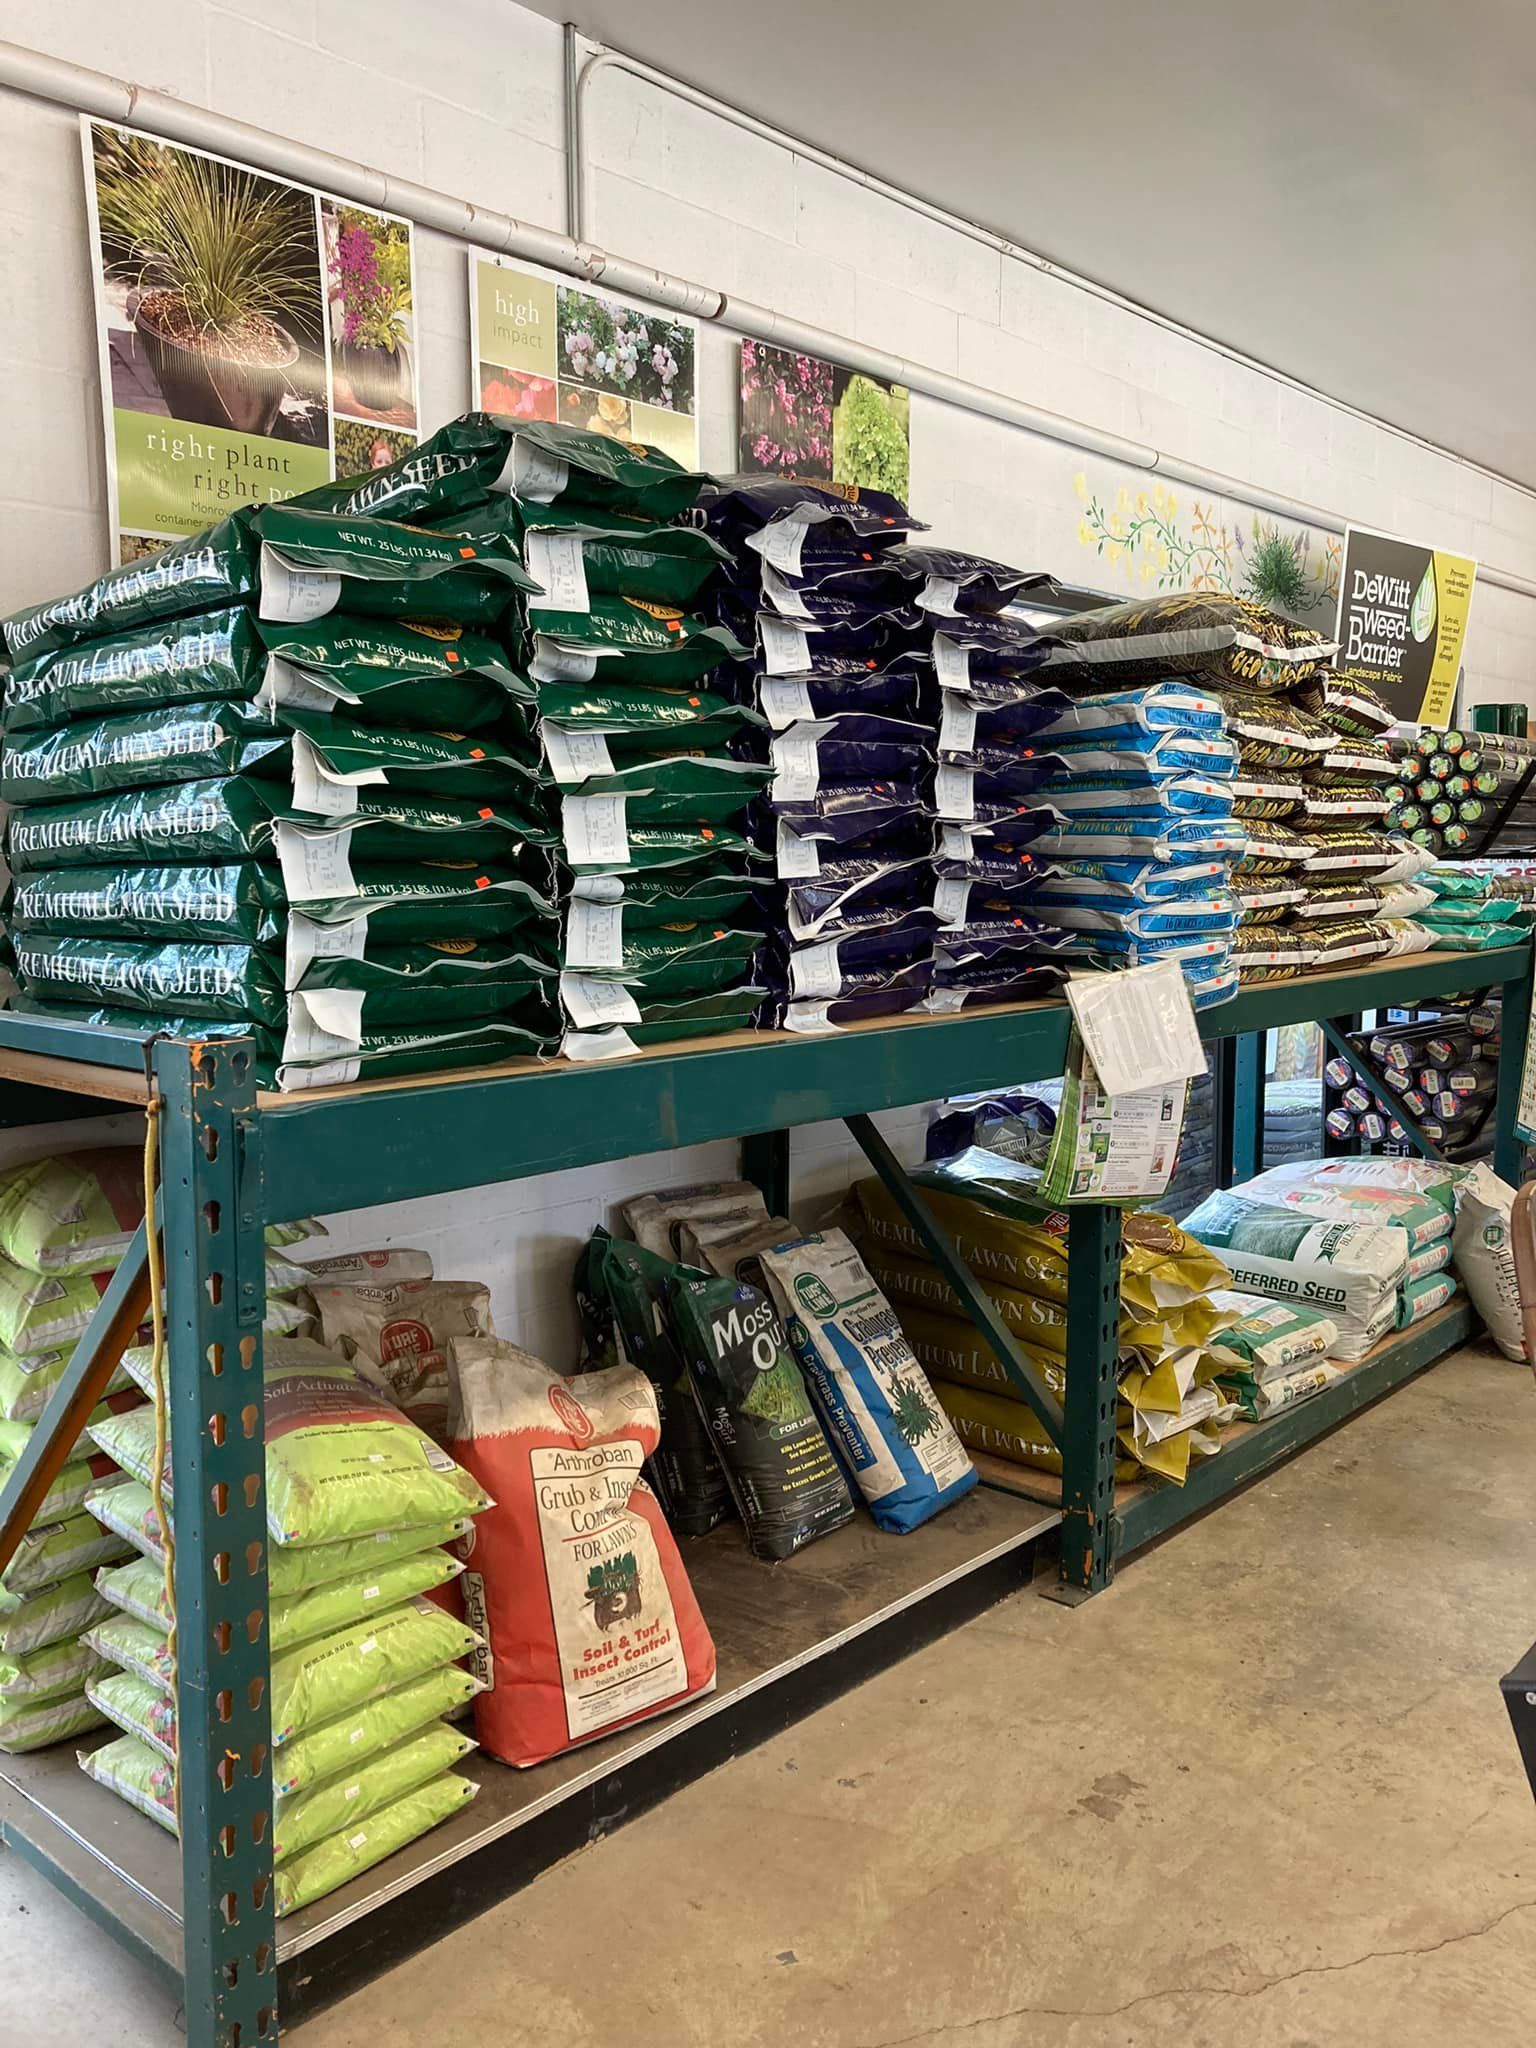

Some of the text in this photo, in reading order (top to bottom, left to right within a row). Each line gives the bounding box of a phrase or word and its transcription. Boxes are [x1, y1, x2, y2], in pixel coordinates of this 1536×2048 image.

[495, 290, 539, 326] high
[492, 320, 543, 349] impact
[147, 429, 291, 474] right plant
[194, 470, 305, 503] right po
[154, 513, 203, 528] container
[338, 531, 357, 544] NET
[378, 541, 391, 551] 25
[408, 547, 438, 560] (11.34
[155, 547, 216, 590] SEED
[1352, 570, 1411, 610] DeWitt
[1350, 605, 1411, 640] Weed-
[334, 640, 354, 650] NET
[355, 640, 374, 650] WT.
[376, 643, 388, 654] 25
[1346, 616, 1401, 667] Barrier
[1345, 664, 1403, 683] Landscape Fabric
[390, 738, 402, 747] 25
[10, 800, 218, 853] PREMIUM LAWN SEED
[367, 804, 386, 815] WT.
[388, 807, 400, 816] 25
[13, 882, 234, 922] PREMIUM LAWN SEED
[400, 884, 412, 896] 25
[14, 944, 233, 997] PREMIUM LAWN SEED
[391, 1036, 403, 1047] 25
[954, 1235, 1019, 1273] LAWN
[1303, 1281, 1347, 1304] SEED
[842, 1308, 900, 1343] Crabgras
[263, 1381, 291, 1402] Soil
[779, 1422, 799, 1435] FOR
[832, 1407, 867, 1462] Preventer
[553, 1447, 633, 1472] Arthroban
[541, 1483, 586, 1511] Grub
[589, 1486, 602, 1502] &
[574, 1520, 638, 1562] FOR LAWNS
[468, 1579, 491, 1685] Arthrban
[583, 1618, 660, 1662] Soil & Turf
[573, 1628, 672, 1681] Insect Control
